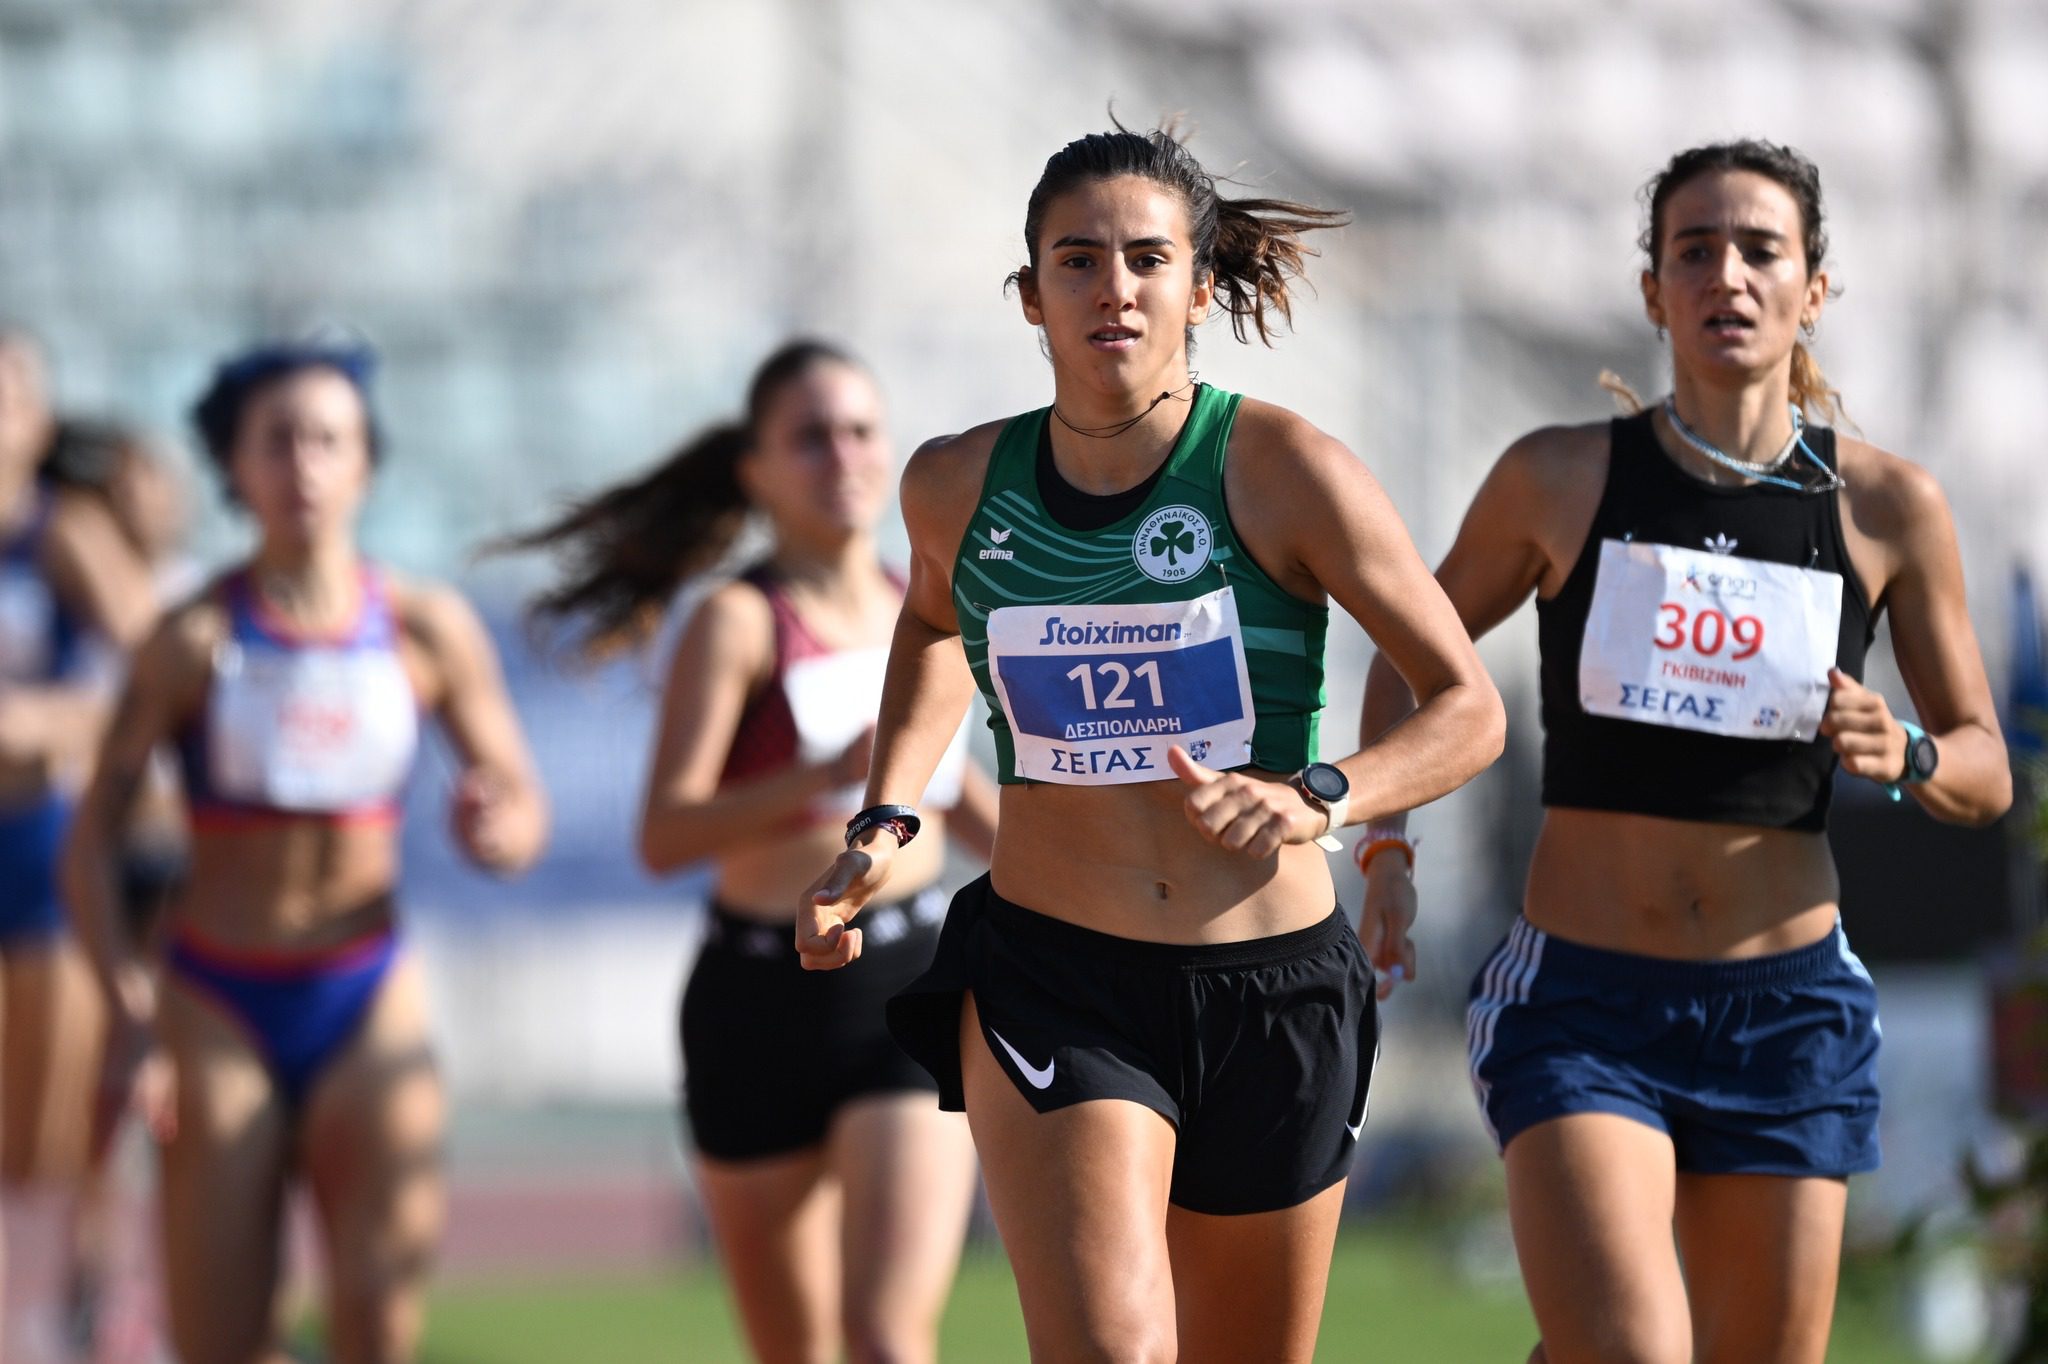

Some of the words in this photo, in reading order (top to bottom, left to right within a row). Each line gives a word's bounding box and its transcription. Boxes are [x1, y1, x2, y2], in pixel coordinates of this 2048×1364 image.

[979, 547, 1014, 560] erima
[1162, 567, 1186, 577] 1908
[1040, 617, 1182, 645] Stoiximan
[1654, 602, 1765, 661] 309
[1066, 660, 1164, 710] 121
[1662, 661, 1746, 688] ΓΚΙΒΙΖΙΝΗ
[1619, 683, 1725, 722] ΣΕΓΑΣ
[1065, 717, 1182, 739] ΔΕΣΠΟΛΛΑΡΗ
[1051, 747, 1154, 774] ΣΕΓΑΣ
